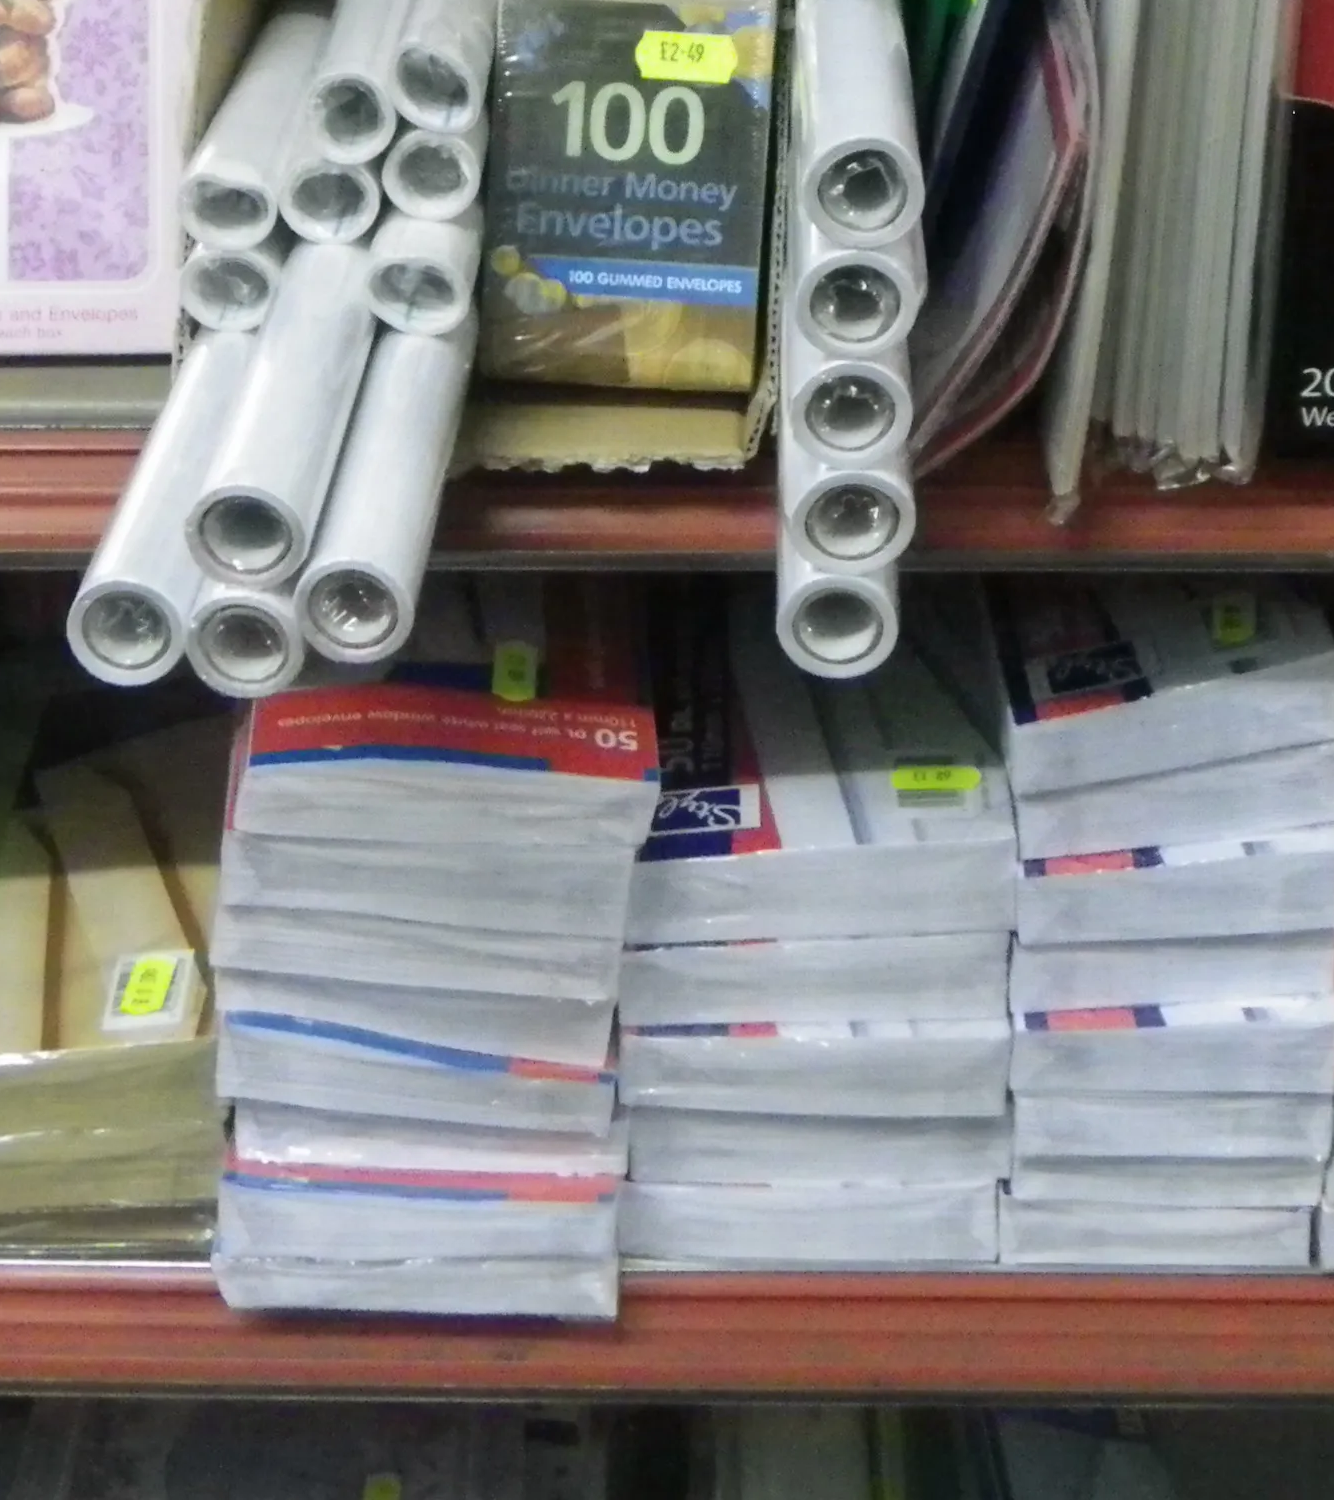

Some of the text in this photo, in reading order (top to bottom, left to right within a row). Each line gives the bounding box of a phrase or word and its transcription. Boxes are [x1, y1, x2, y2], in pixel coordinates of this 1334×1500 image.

[551, 79, 705, 165] 100
[623, 172, 738, 211] Money
[515, 203, 724, 251] Envelopes
[568, 268, 744, 294] 100 GUMMED ENVELOPES
[594, 728, 639, 752] 50
